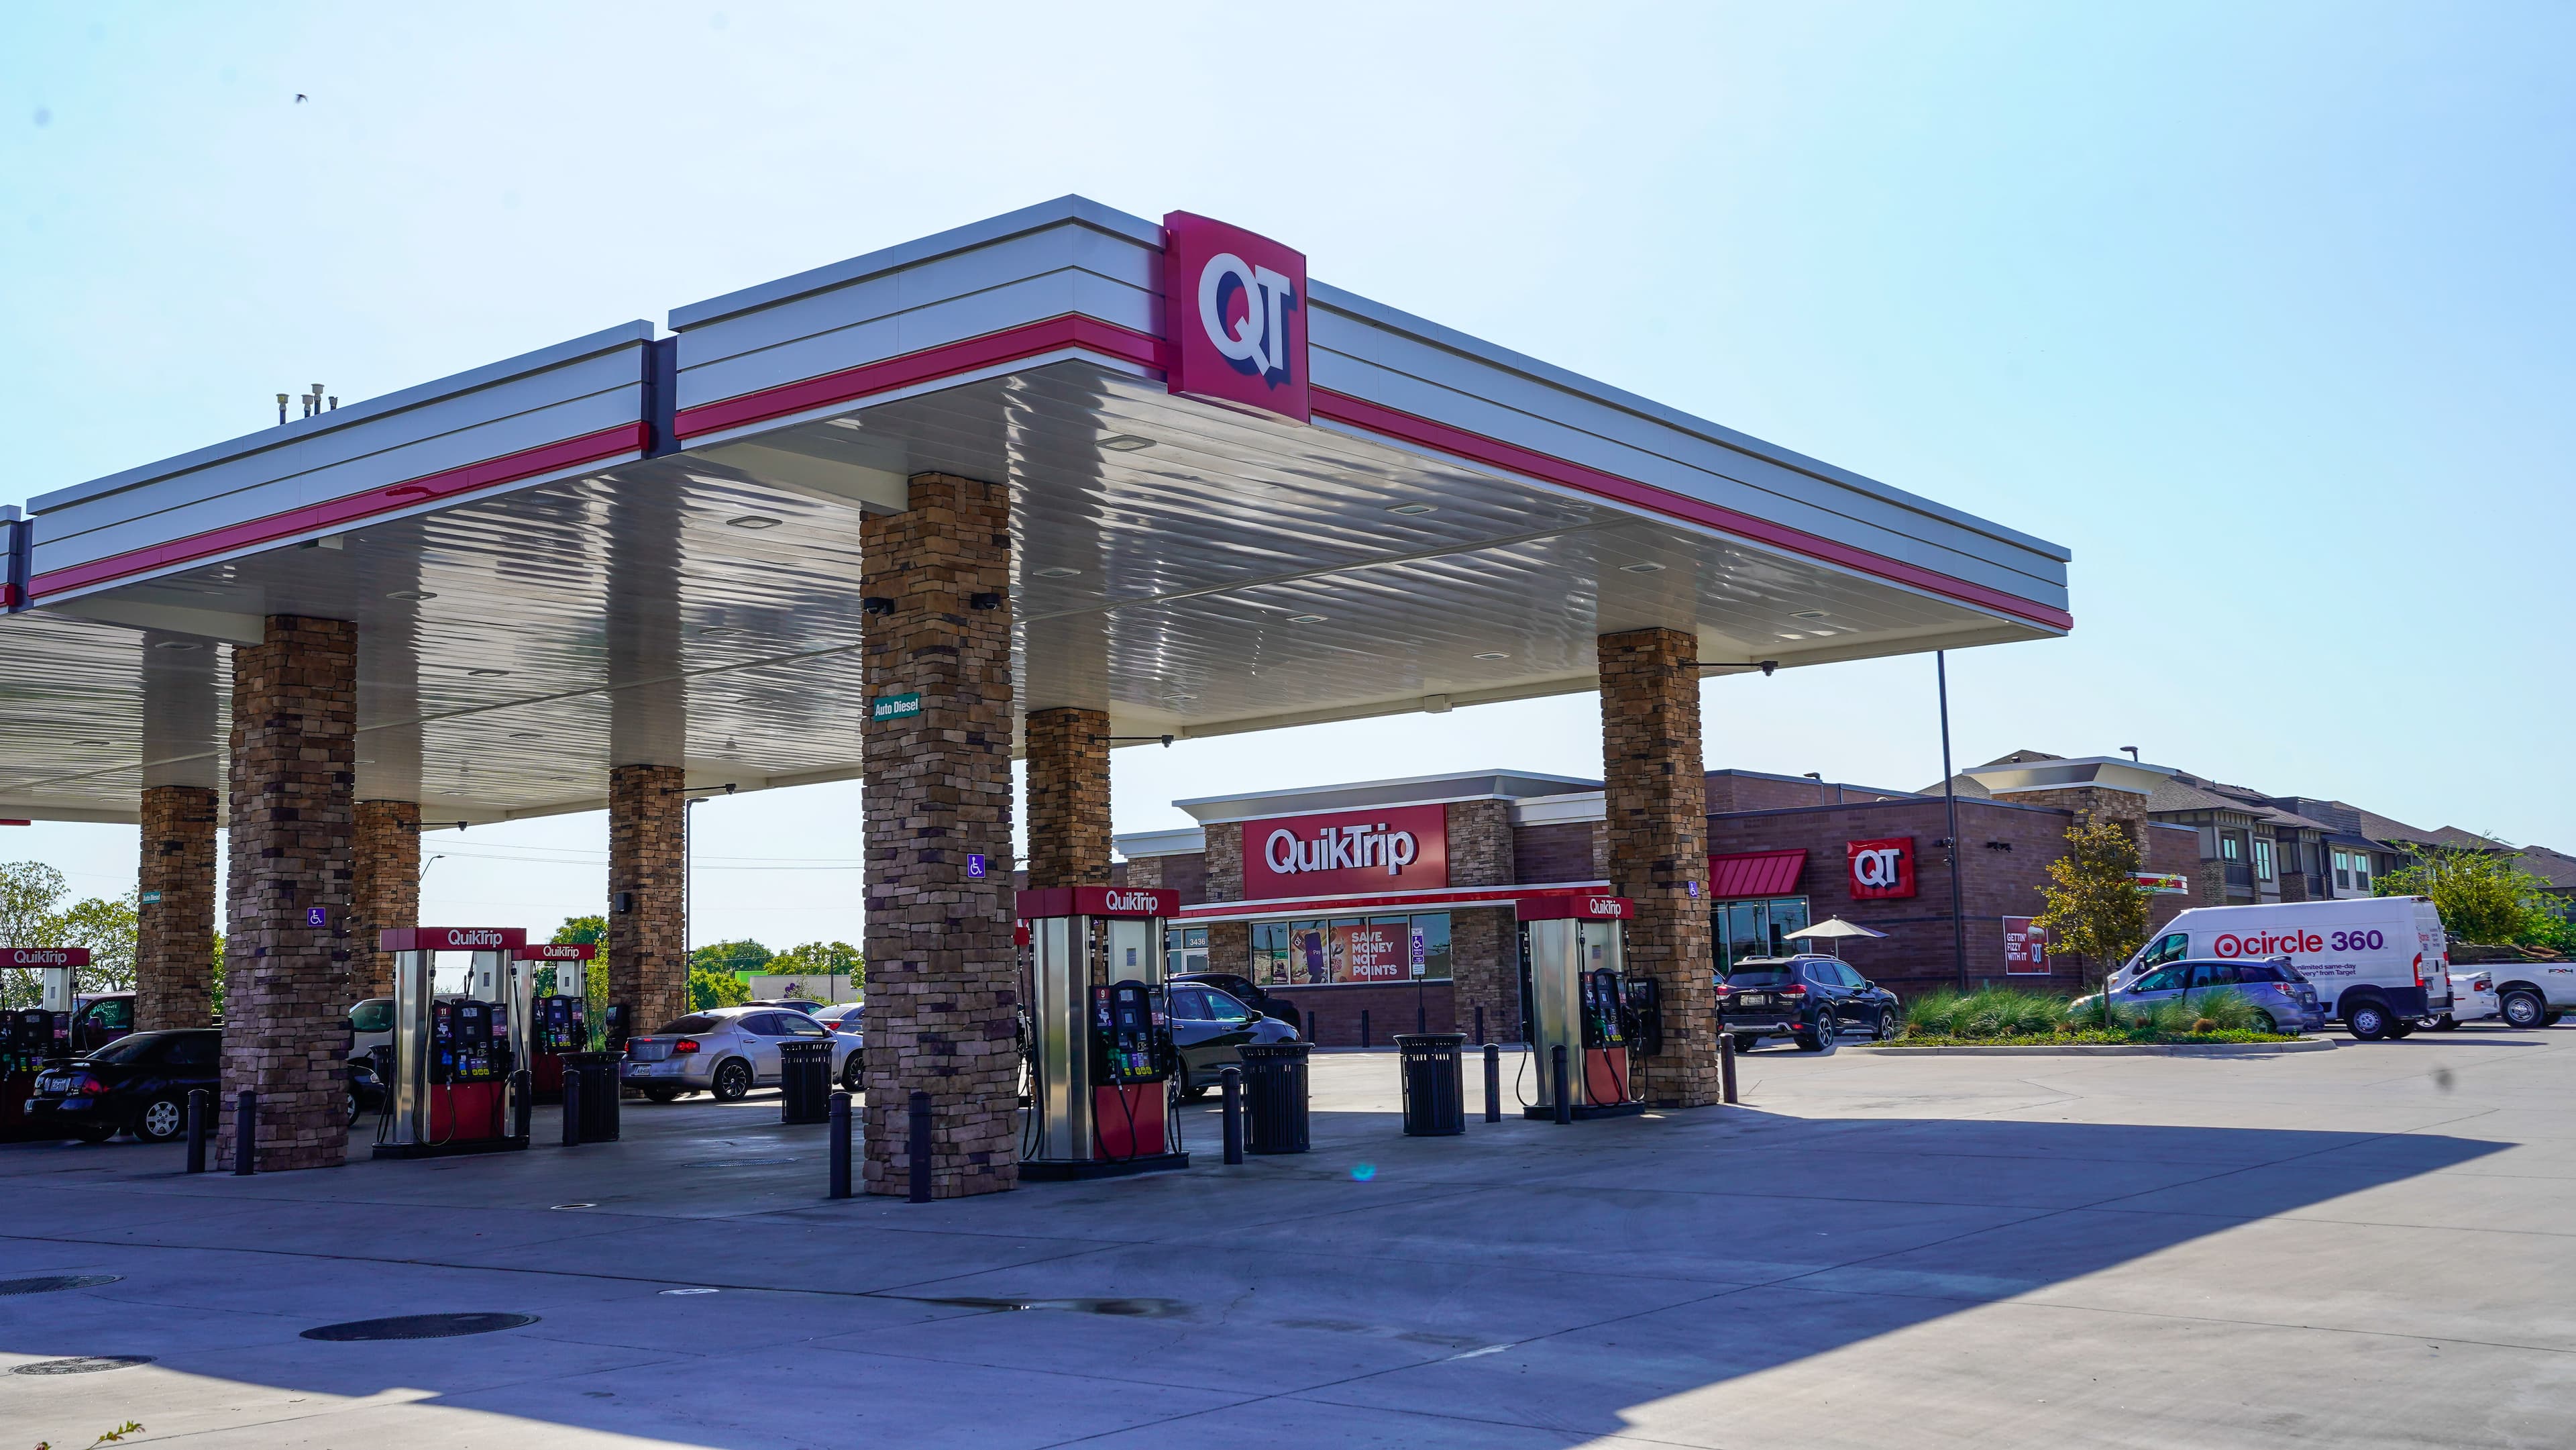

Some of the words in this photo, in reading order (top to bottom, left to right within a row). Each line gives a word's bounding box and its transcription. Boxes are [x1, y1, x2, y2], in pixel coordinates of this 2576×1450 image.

[1198, 252, 1291, 376] QT
[875, 704, 892, 716] Auto
[894, 698, 918, 713] Diesel
[1265, 823, 1415, 876] QuikTrip
[1854, 848, 1900, 887] QT
[1106, 890, 1158, 914] QuikTrip
[1590, 898, 1621, 918] QuikTrip
[447, 929, 502, 947] QuikTrip
[1352, 931, 1383, 942] SAVE
[2006, 933, 2027, 942] GETTIN'
[2243, 929, 2323, 955] circle
[2331, 930, 2383, 951] 360
[543, 945, 580, 959] QuikTrip
[1352, 942, 1394, 953] MONEY
[2006, 943, 2021, 951] FIZZY
[2031, 943, 2042, 964] QT
[13, 949, 68, 966] QuikTrip
[1352, 954, 1377, 965] NOT
[2007, 952, 2021, 961] WITH
[2021, 952, 2027, 961] IT
[1353, 964, 1397, 976] POINTS
[1101, 989, 1106, 998] 9
